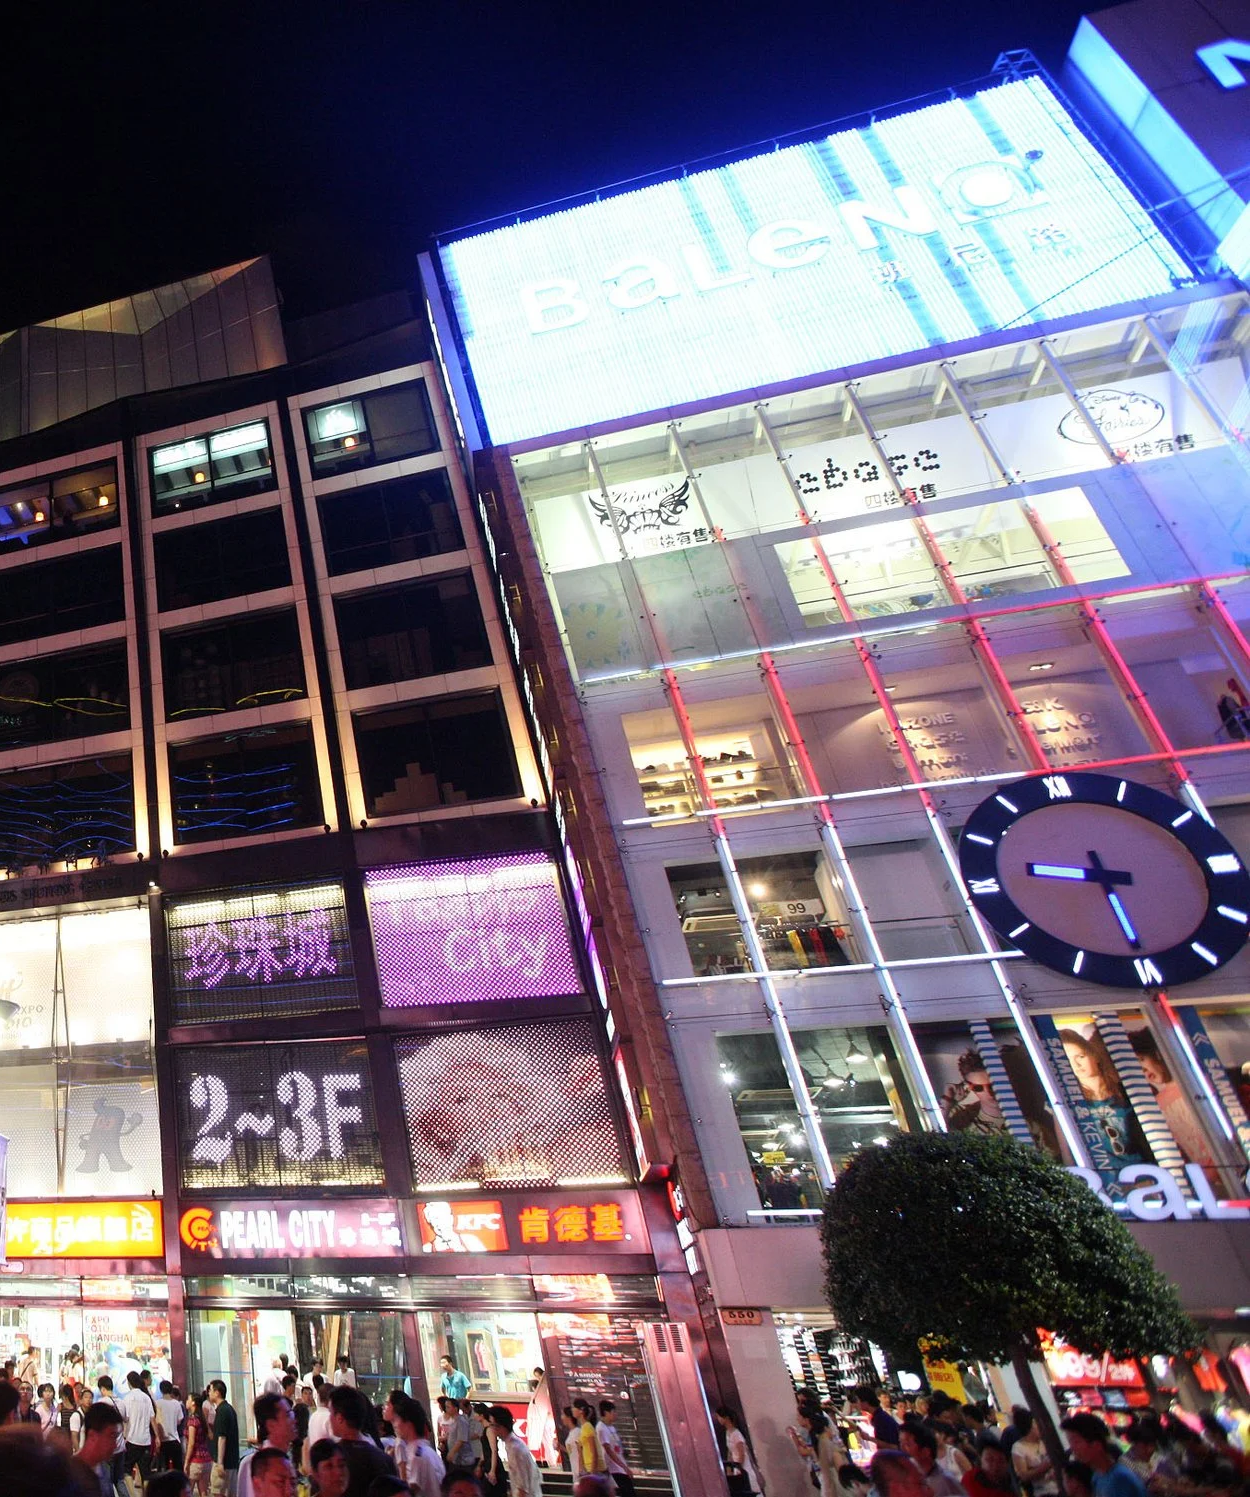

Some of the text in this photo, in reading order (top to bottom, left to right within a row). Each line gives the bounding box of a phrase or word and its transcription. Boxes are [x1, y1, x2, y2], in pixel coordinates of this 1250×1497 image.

[787, 902, 806, 914] 99
[184, 908, 338, 990] 珍珠城
[1080, 1120, 1112, 1171] KEVIN
[219, 1209, 336, 1249] PEARL CITY
[455, 1213, 502, 1231] KFC
[517, 1203, 625, 1245] 肯德基
